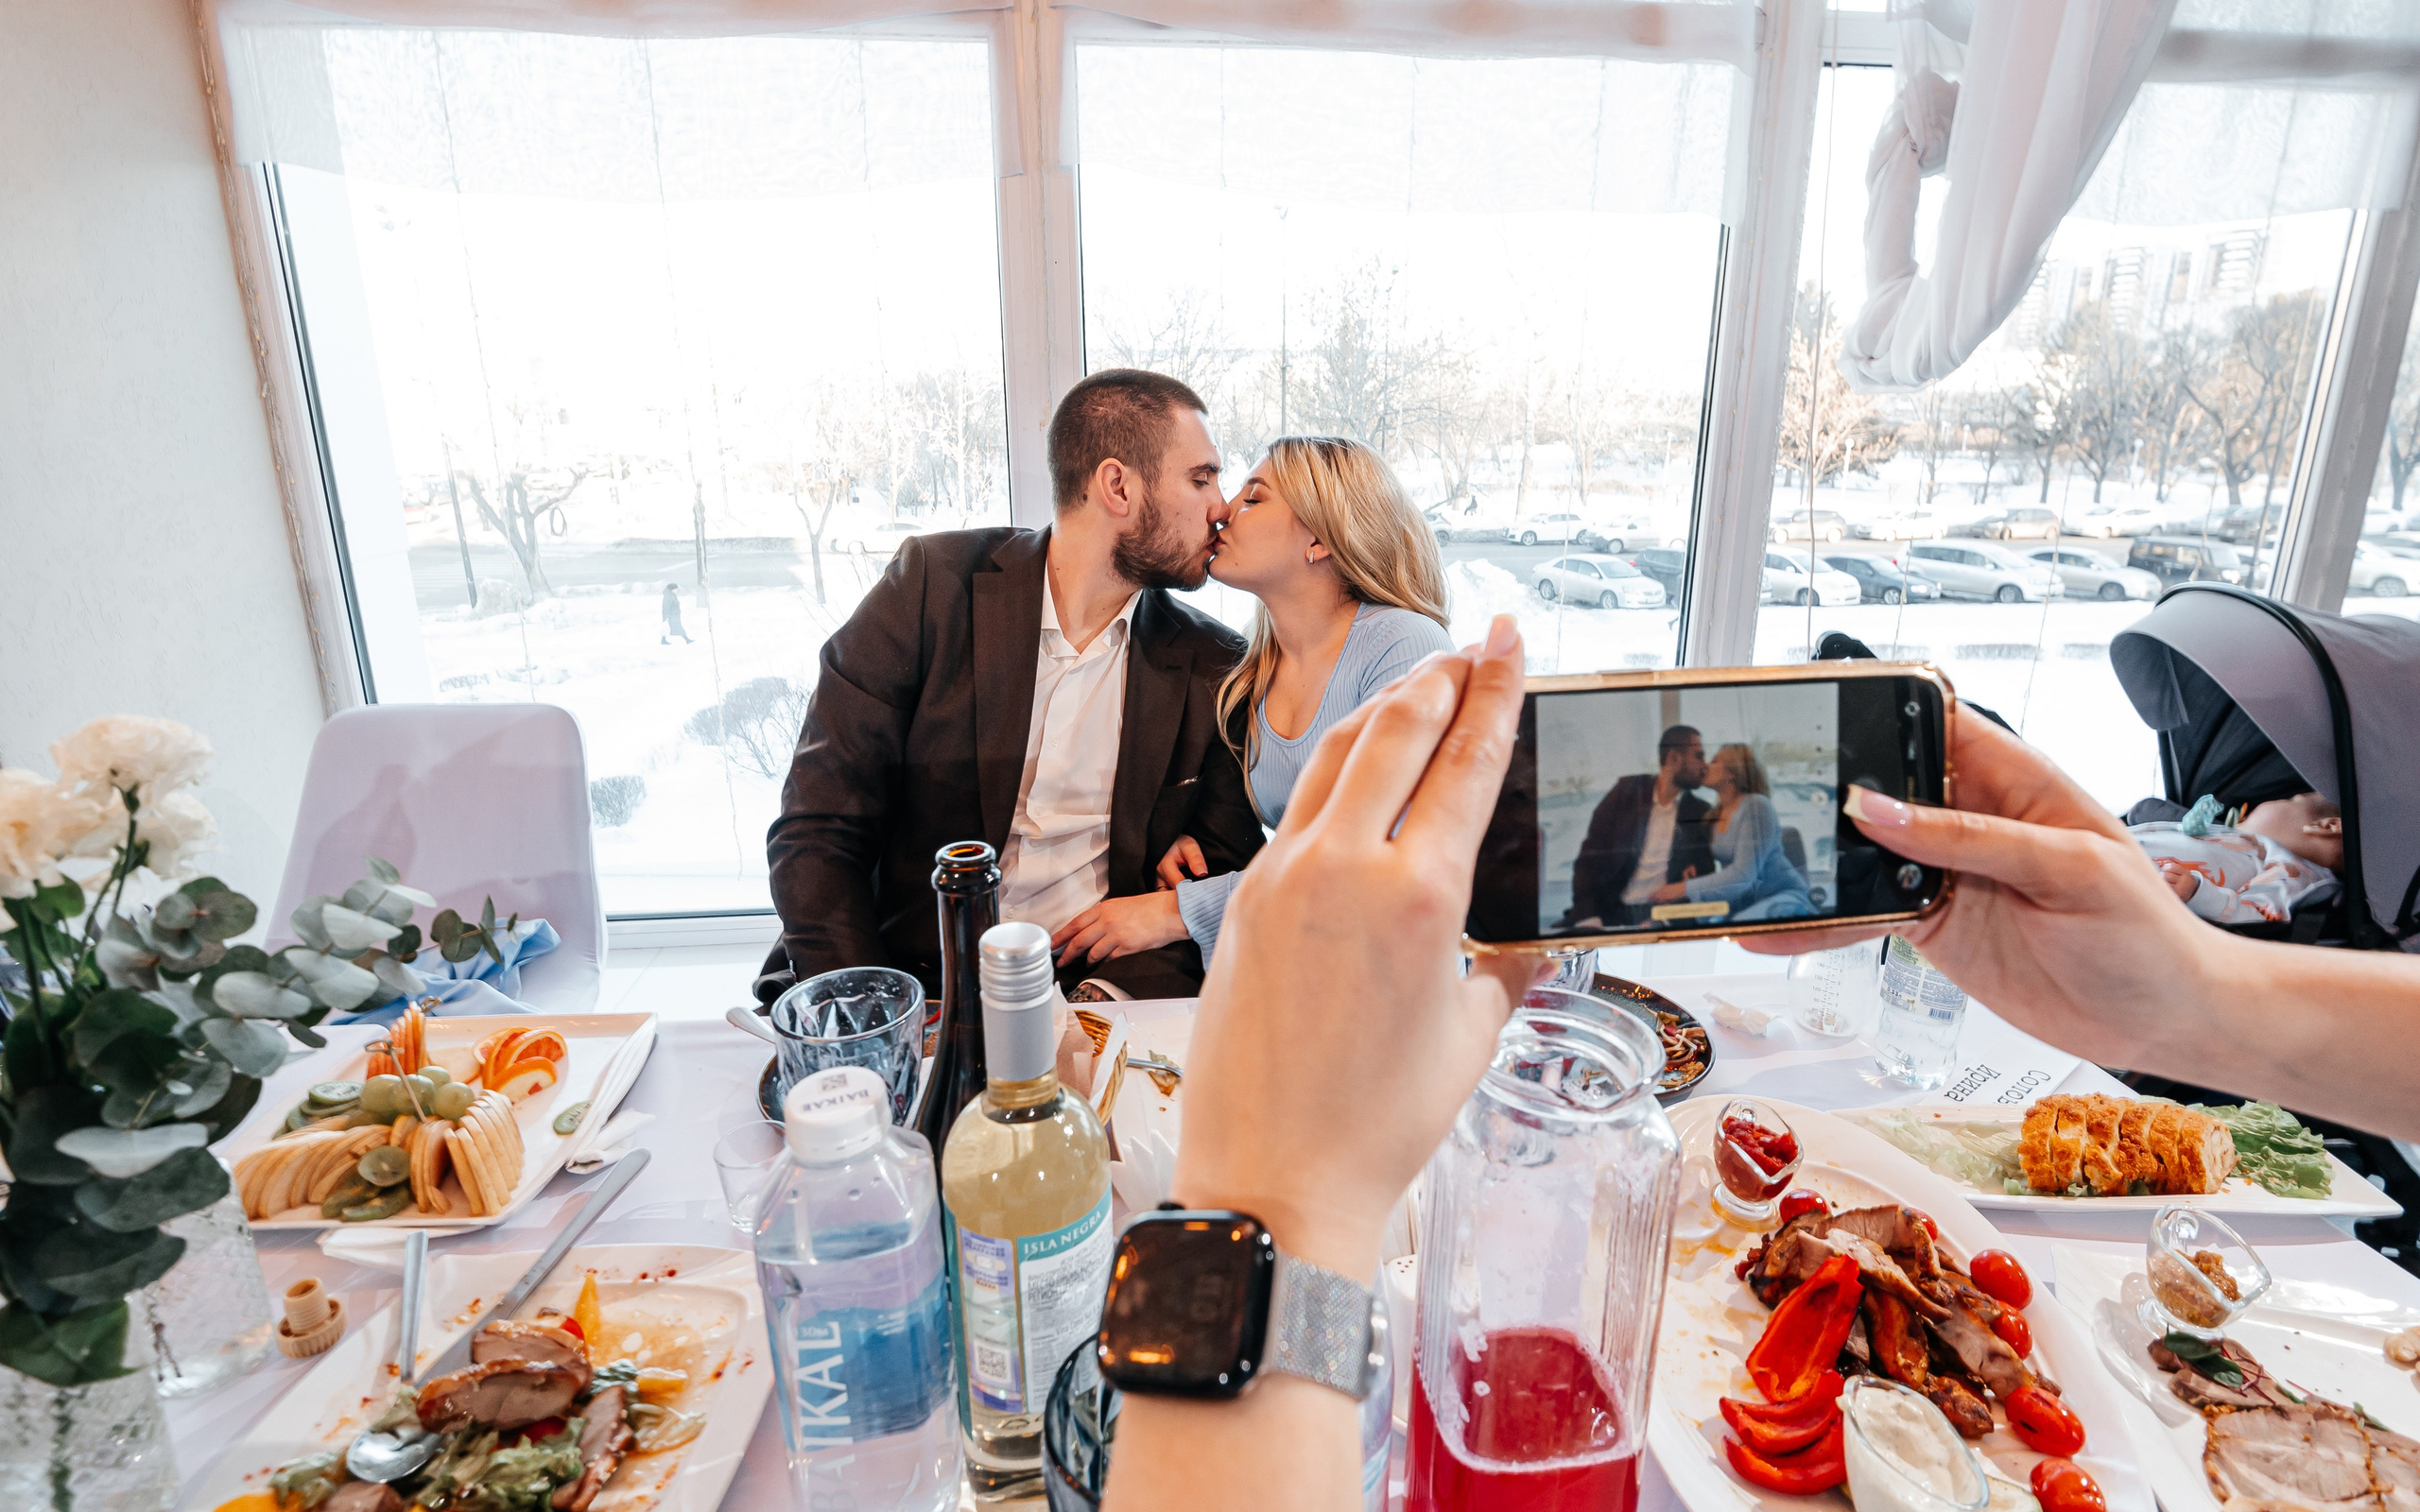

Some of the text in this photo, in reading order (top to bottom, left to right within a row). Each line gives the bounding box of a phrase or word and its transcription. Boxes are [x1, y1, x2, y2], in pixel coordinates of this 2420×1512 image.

[1944, 1063, 2001, 1103] Ирина
[1996, 1070, 2051, 1105] Солов
[1024, 1238, 1058, 1255] ISLA
[1061, 1211, 1101, 1246] NEGRA
